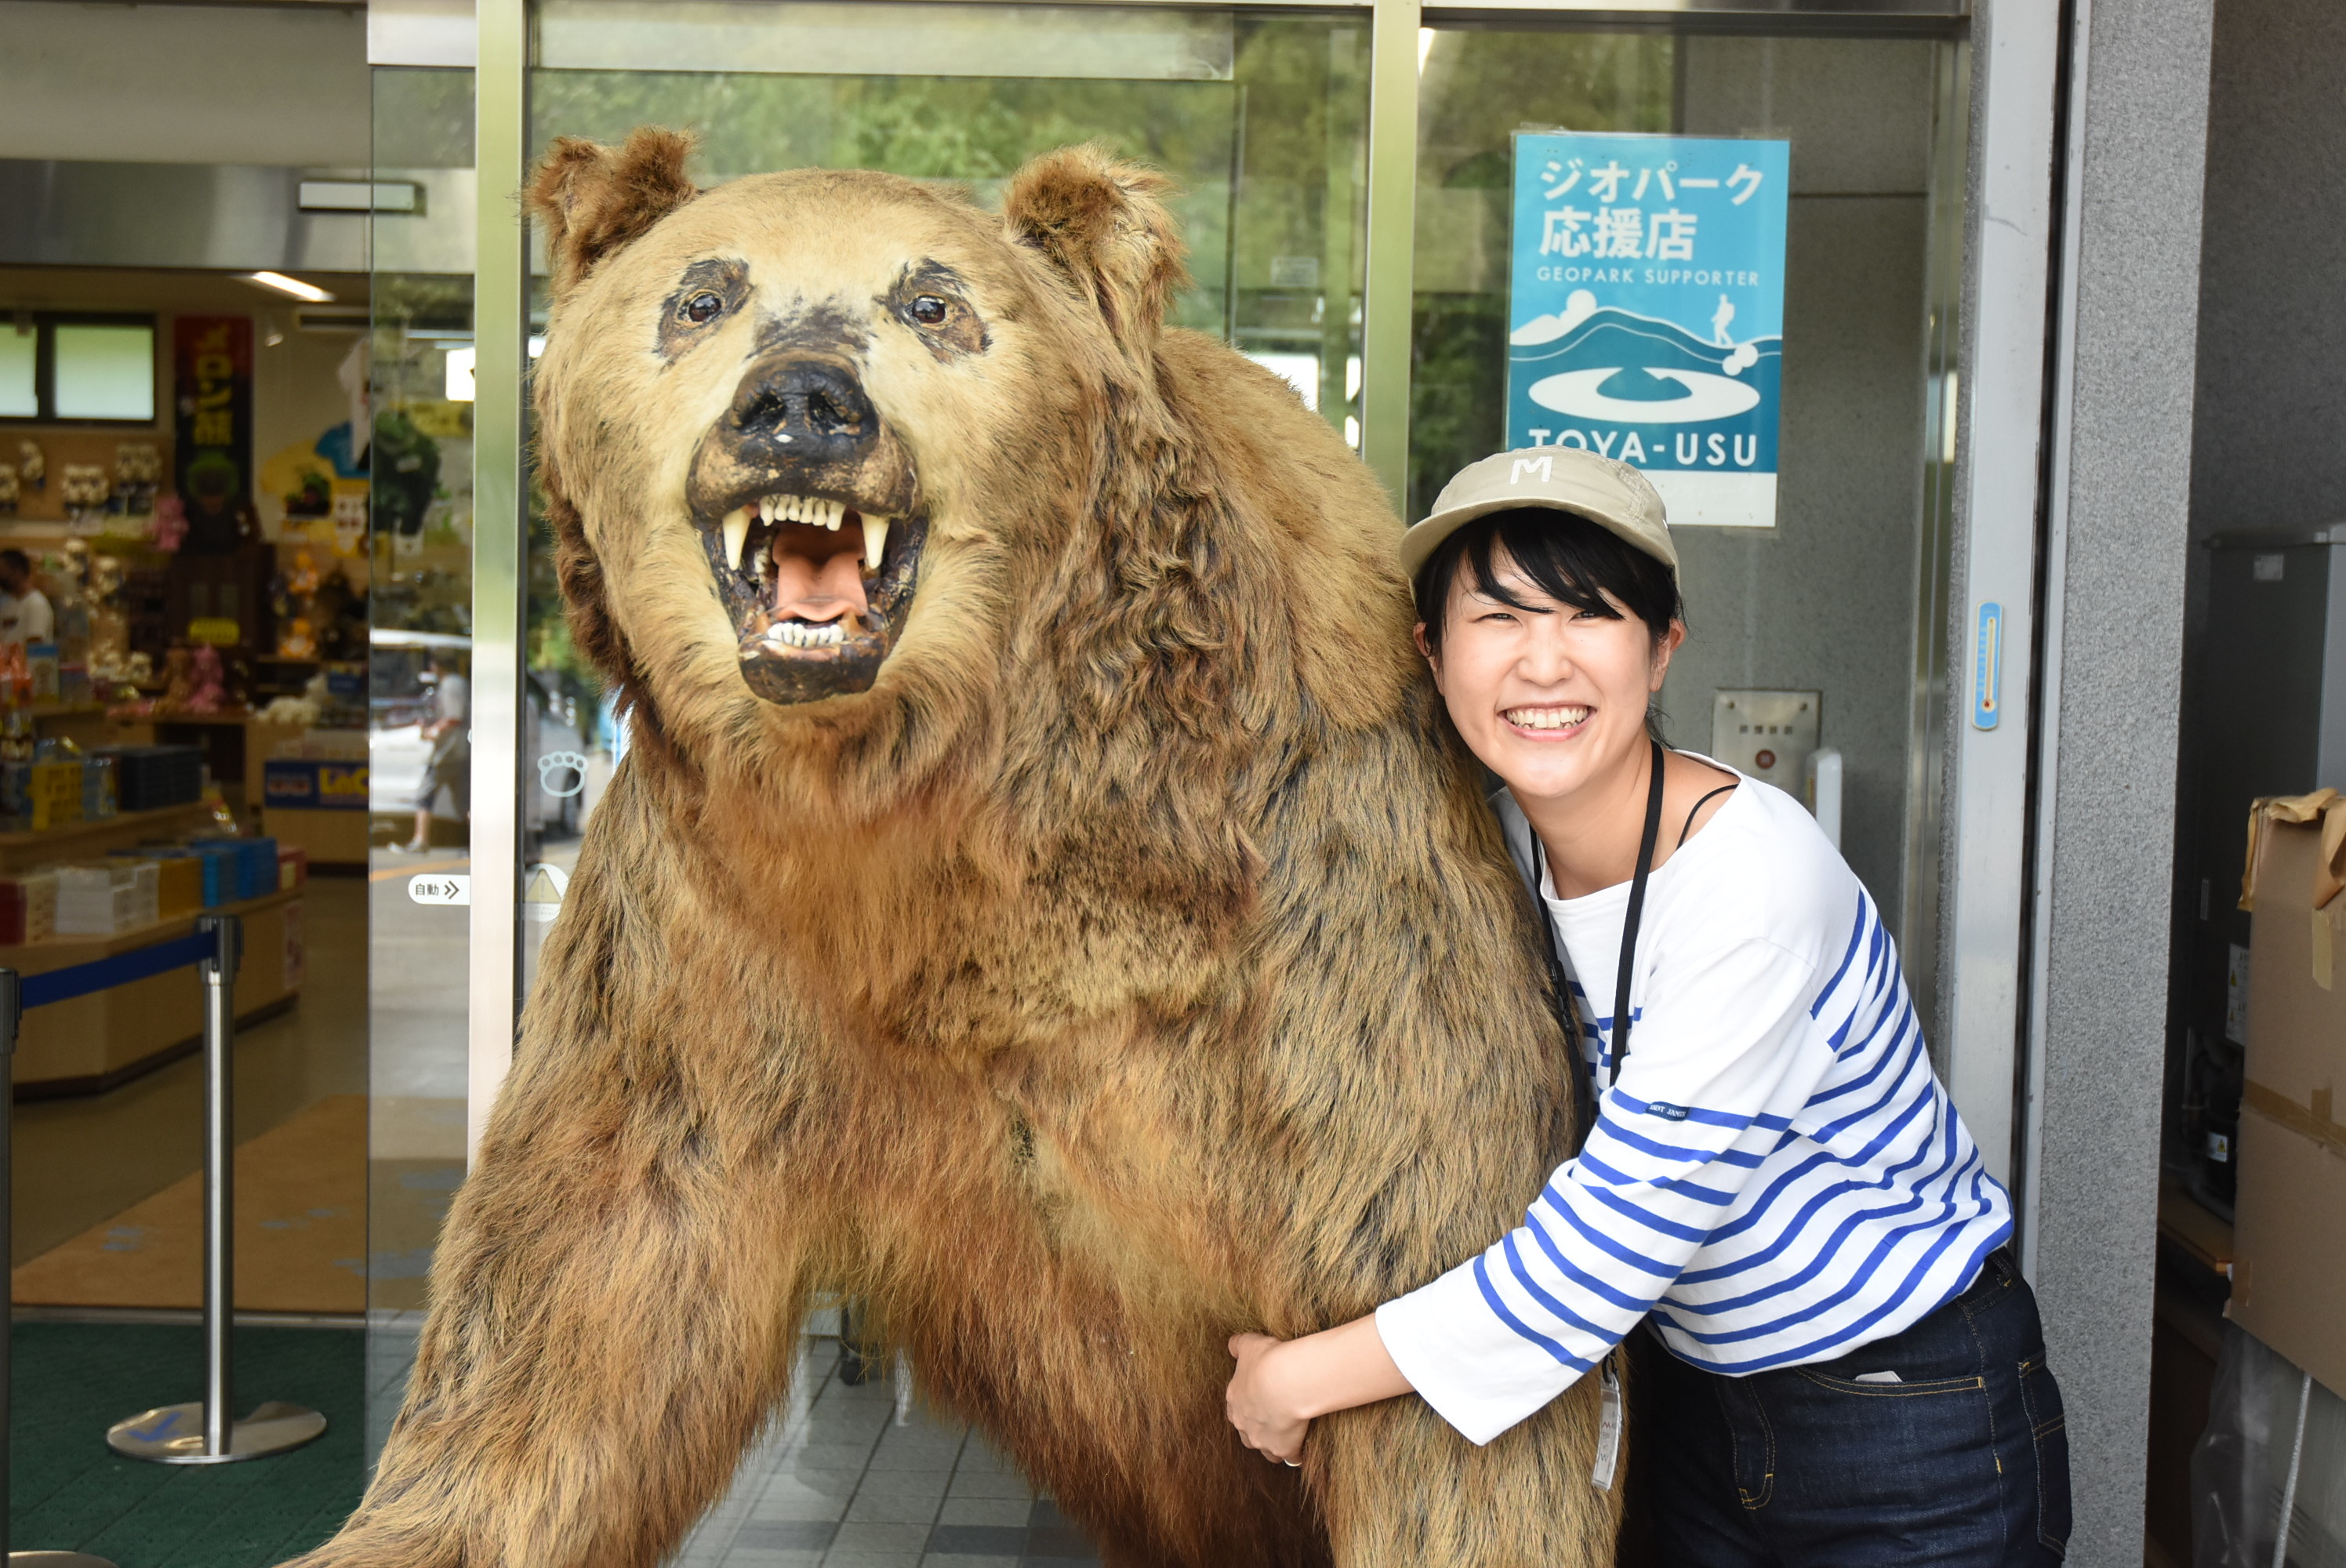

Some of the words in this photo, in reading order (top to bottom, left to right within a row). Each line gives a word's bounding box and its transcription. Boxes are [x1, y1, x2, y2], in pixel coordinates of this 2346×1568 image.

[1541, 158, 1763, 206] ジオパーク
[1539, 206, 1698, 261] 応援店
[1537, 267, 1633, 283] GEOPARK
[1645, 269, 1759, 285] SUPPORTER
[1509, 456, 1552, 485] M
[415, 883, 439, 896] 自動
